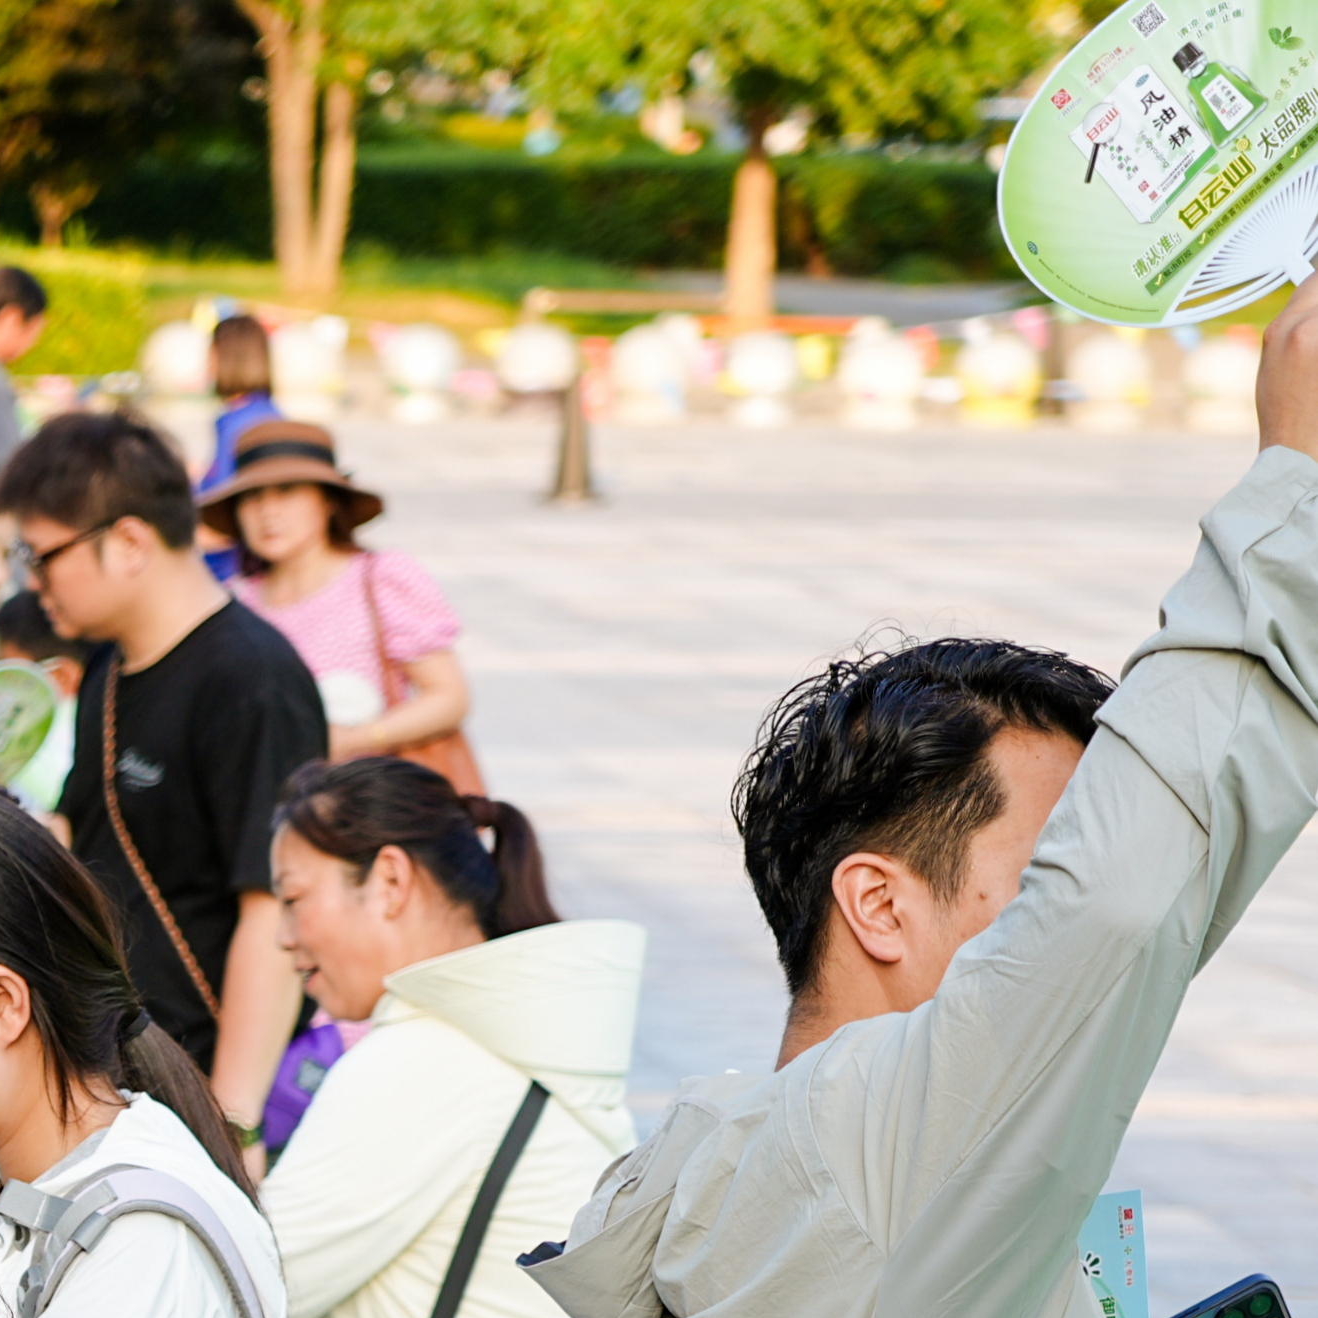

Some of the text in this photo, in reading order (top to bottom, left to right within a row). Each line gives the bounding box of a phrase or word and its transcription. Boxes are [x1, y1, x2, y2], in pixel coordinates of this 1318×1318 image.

[1087, 107, 1119, 141] 白云山
[1140, 90, 1192, 150] 风油精
[1178, 153, 1256, 231] 白云山
